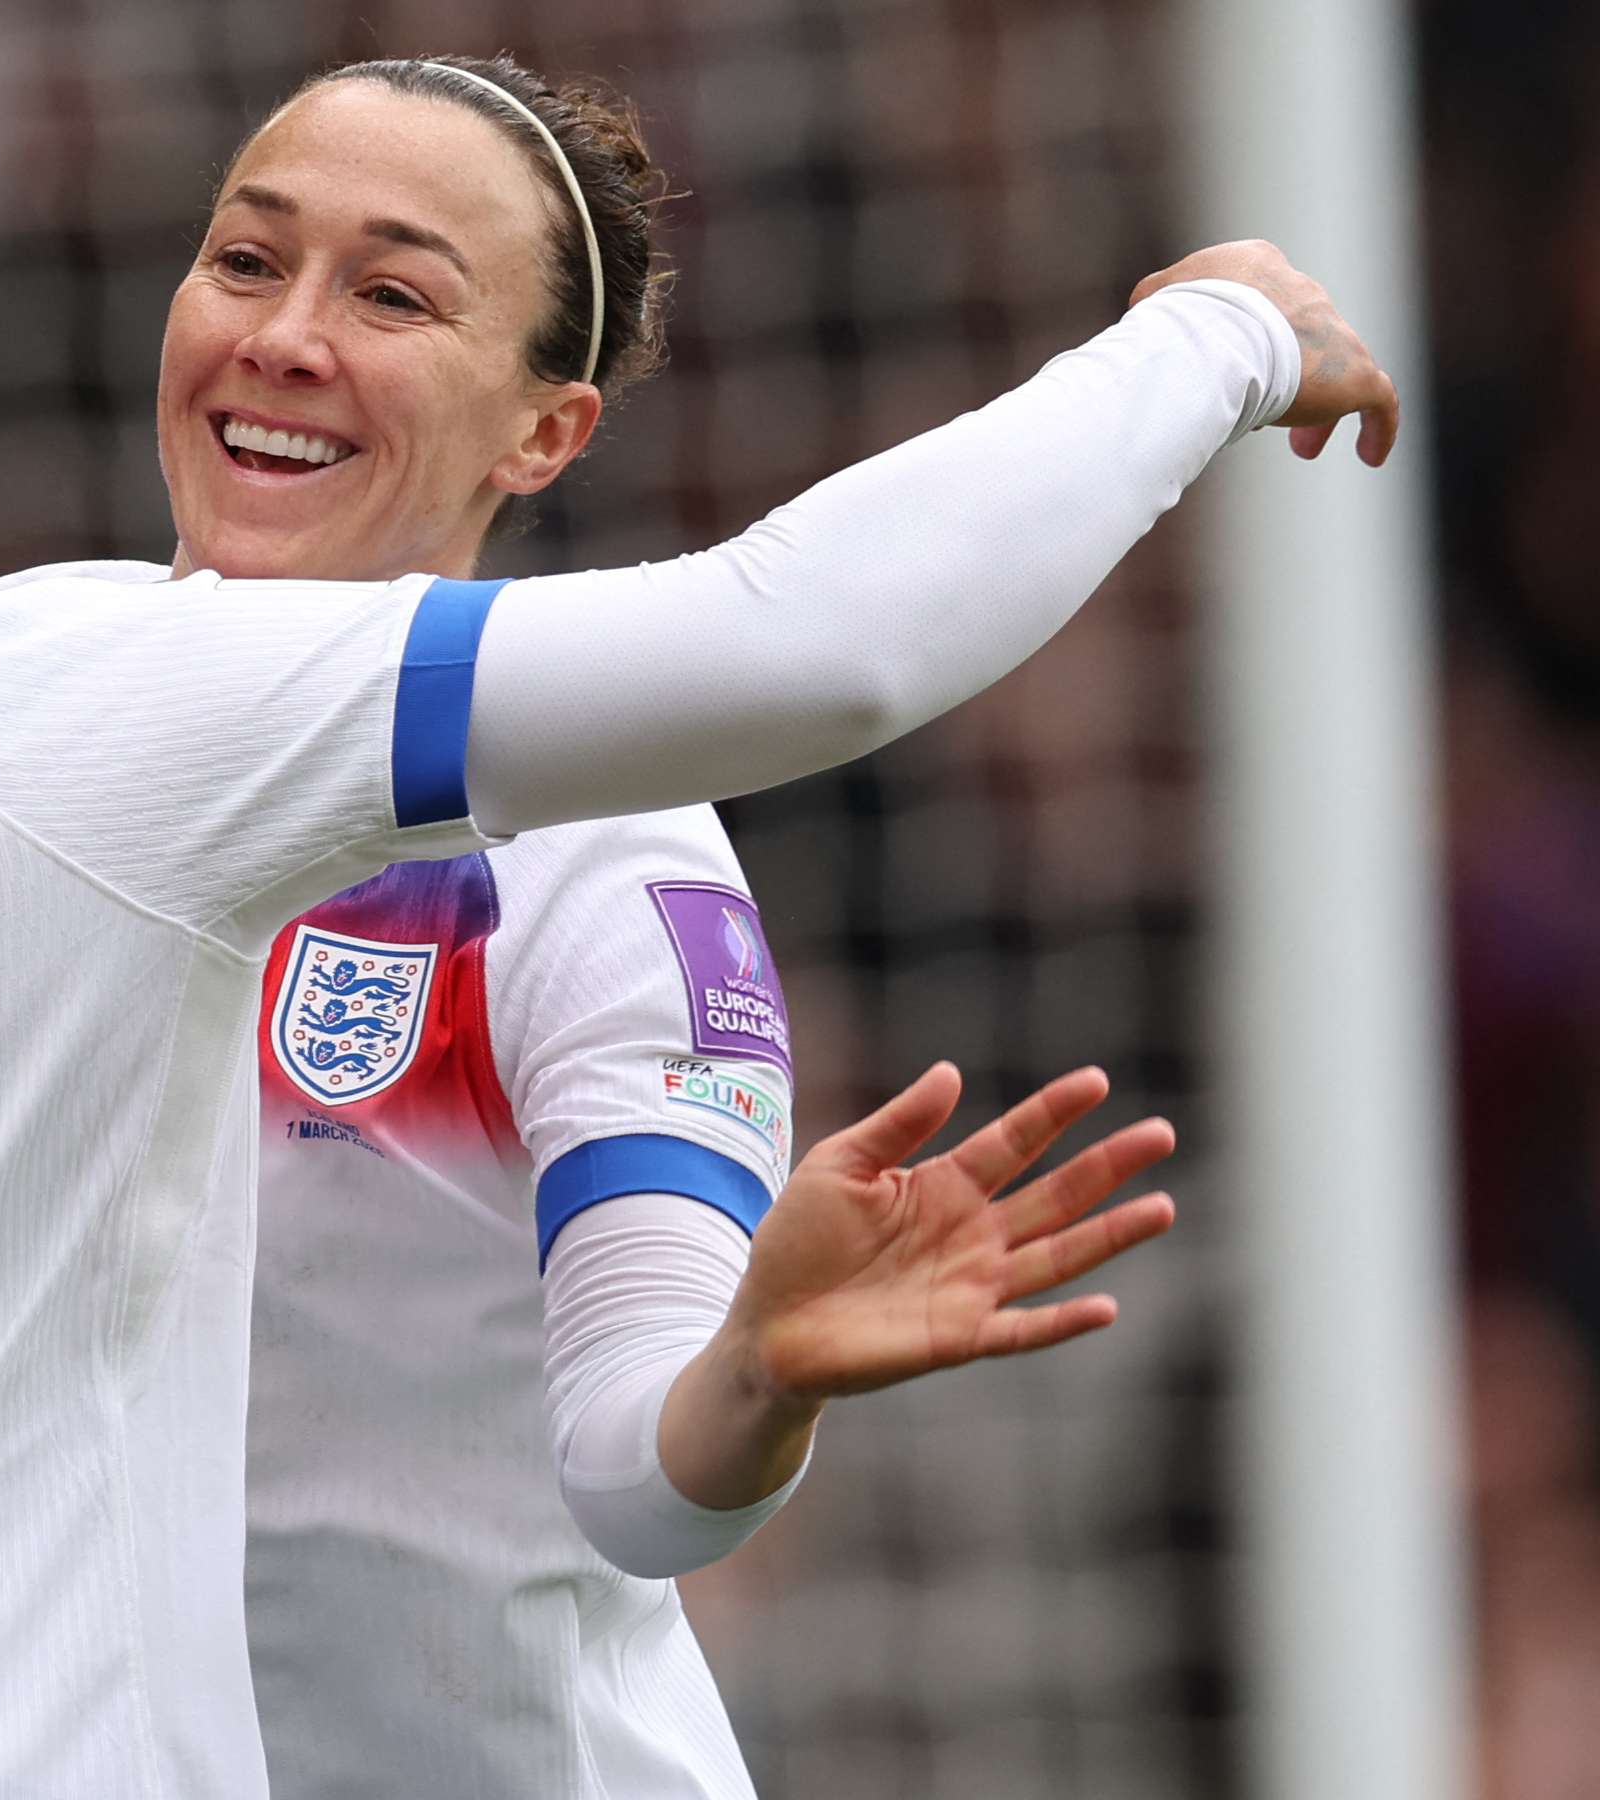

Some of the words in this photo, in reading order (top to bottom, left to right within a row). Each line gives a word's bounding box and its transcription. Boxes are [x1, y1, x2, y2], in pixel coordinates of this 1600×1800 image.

[662, 1059, 713, 1076] UEFA
[286, 1120, 296, 1139] 1
[299, 1120, 349, 1141] MARCH
